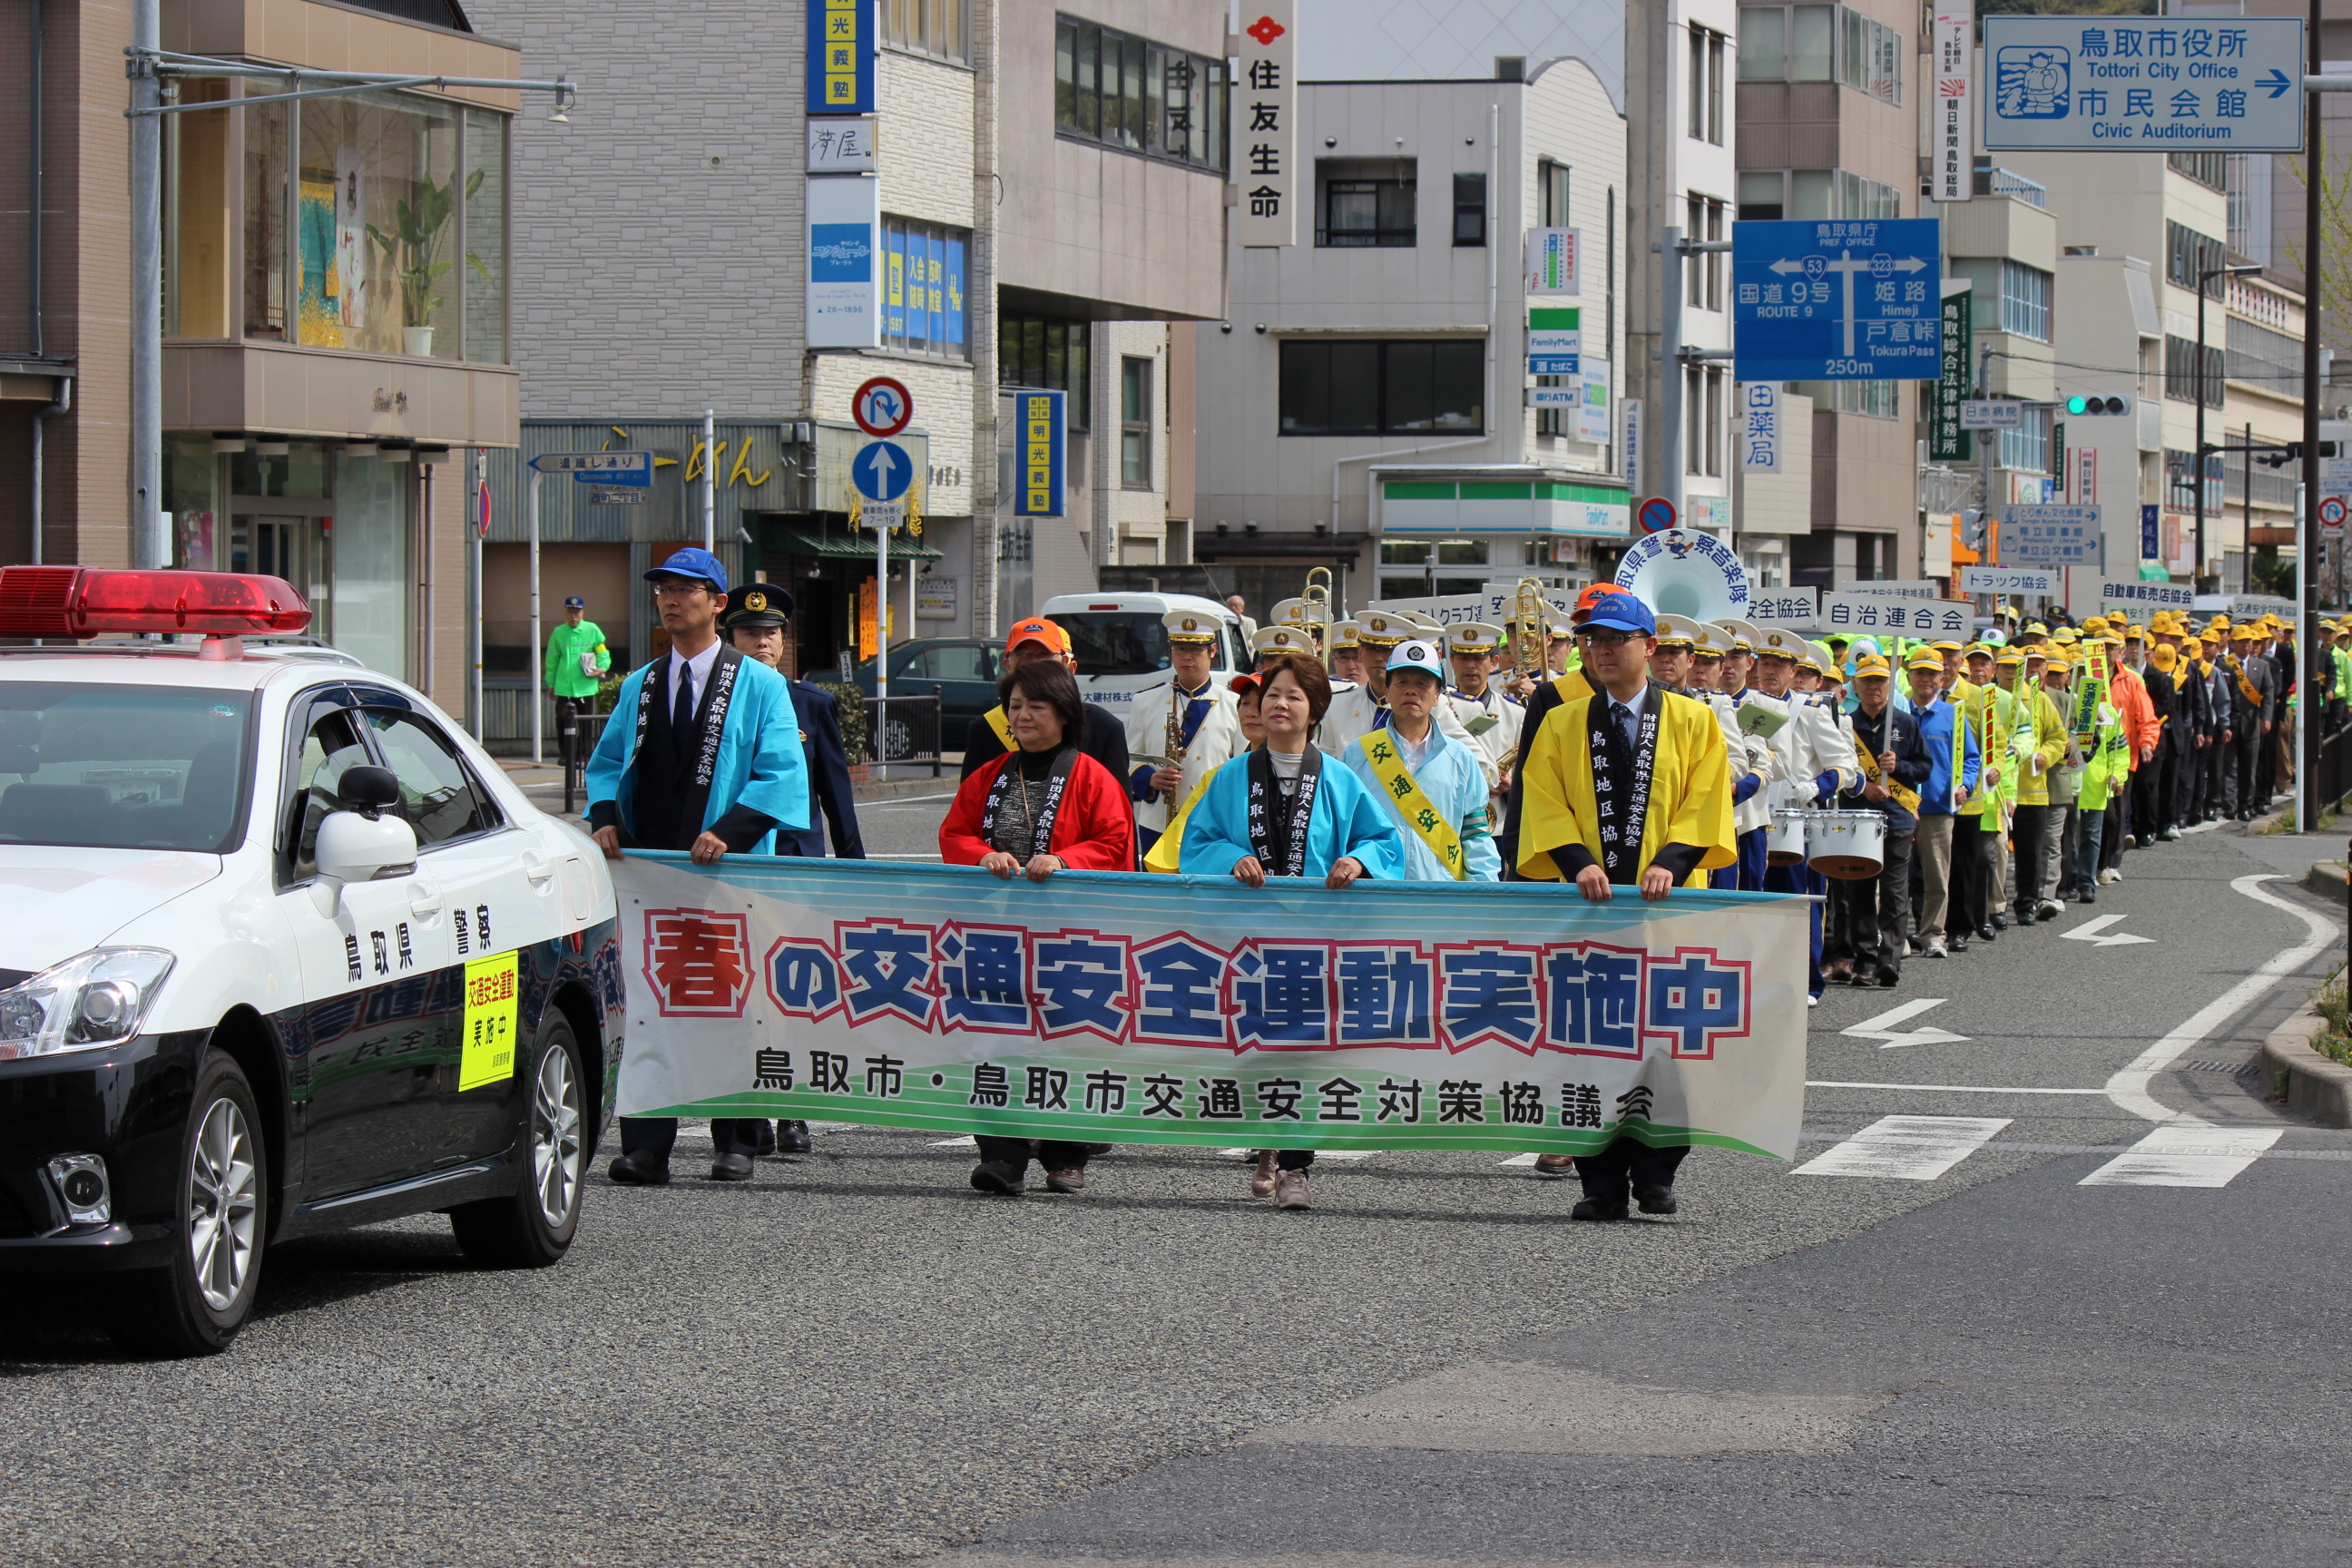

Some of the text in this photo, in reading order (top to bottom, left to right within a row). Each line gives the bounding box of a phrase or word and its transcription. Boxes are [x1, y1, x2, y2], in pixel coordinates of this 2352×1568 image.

[832, 0, 849, 98] 光義塾
[2078, 27, 2248, 59] 鳥取市役所
[2087, 62, 2239, 82] Tottori City Office
[2078, 88, 2248, 119] 市民会館
[1249, 59, 1282, 218] 住友生命
[2092, 122, 2231, 139] Civic Auditorium
[1946, 99, 1958, 198] 朝日新聞鳥取総局
[1817, 222, 1878, 238] 鳥取県庁
[1819, 238, 1876, 247] PREF. OFFICE
[909, 256, 925, 281] 入会
[1807, 260, 1823, 273] 53
[1872, 260, 1892, 271] 323
[1740, 282, 1831, 304] 国道9号
[1875, 281, 1926, 302] 姫路
[1757, 307, 1813, 318] ROUTE 9
[1882, 305, 1919, 318] Himeji
[1867, 321, 1936, 342] 戸倉峠
[1532, 338, 1576, 348] FamilyMart
[1868, 346, 1936, 357] Tokura Pass
[1536, 361, 1573, 372] 酒 たばこ
[1826, 359, 1874, 376] 250m
[1942, 304, 1958, 454] 鳥取総合法律事務所
[1536, 393, 1573, 402] 銀行ATM
[1966, 407, 2018, 417] 日赤病院
[1992, 418, 2018, 426] Hospital
[1033, 425, 1045, 506] 明光義塾
[2082, 460, 2092, 495] 朝日新聞
[591, 493, 639, 503] 西町二丁目
[863, 505, 901, 514] 軽車両を除く
[2020, 508, 2083, 518] とりぎん文化会館
[2020, 527, 2083, 537] 県立図書館
[2020, 546, 2083, 556] 県立公文書館
[1970, 573, 2048, 590] トラック協会
[2103, 583, 2192, 604] 自動車販売店協会
[1831, 603, 1964, 631] 自治連合会
[695, 662, 737, 787] 財団法人 鳥取県交通安全協会
[1298, 773, 1316, 808] 財団法人
[1623, 713, 1657, 848] 財団法人 鳥取県交通安全協会
[1371, 740, 1459, 865] 交通安全
[1592, 730, 1619, 868] 鳥取地区協会
[1032, 776, 1066, 858] 財団法人 鳥取県交
[344, 903, 491, 984] 鳥取県 警察
[468, 968, 514, 1009] 交通安全運動
[646, 910, 1747, 1057] 春の交通安全運動実施中
[474, 1012, 506, 1049] 実施中
[751, 1046, 1655, 1129] 鳥取市・鳥取市交通安全対策協議会
